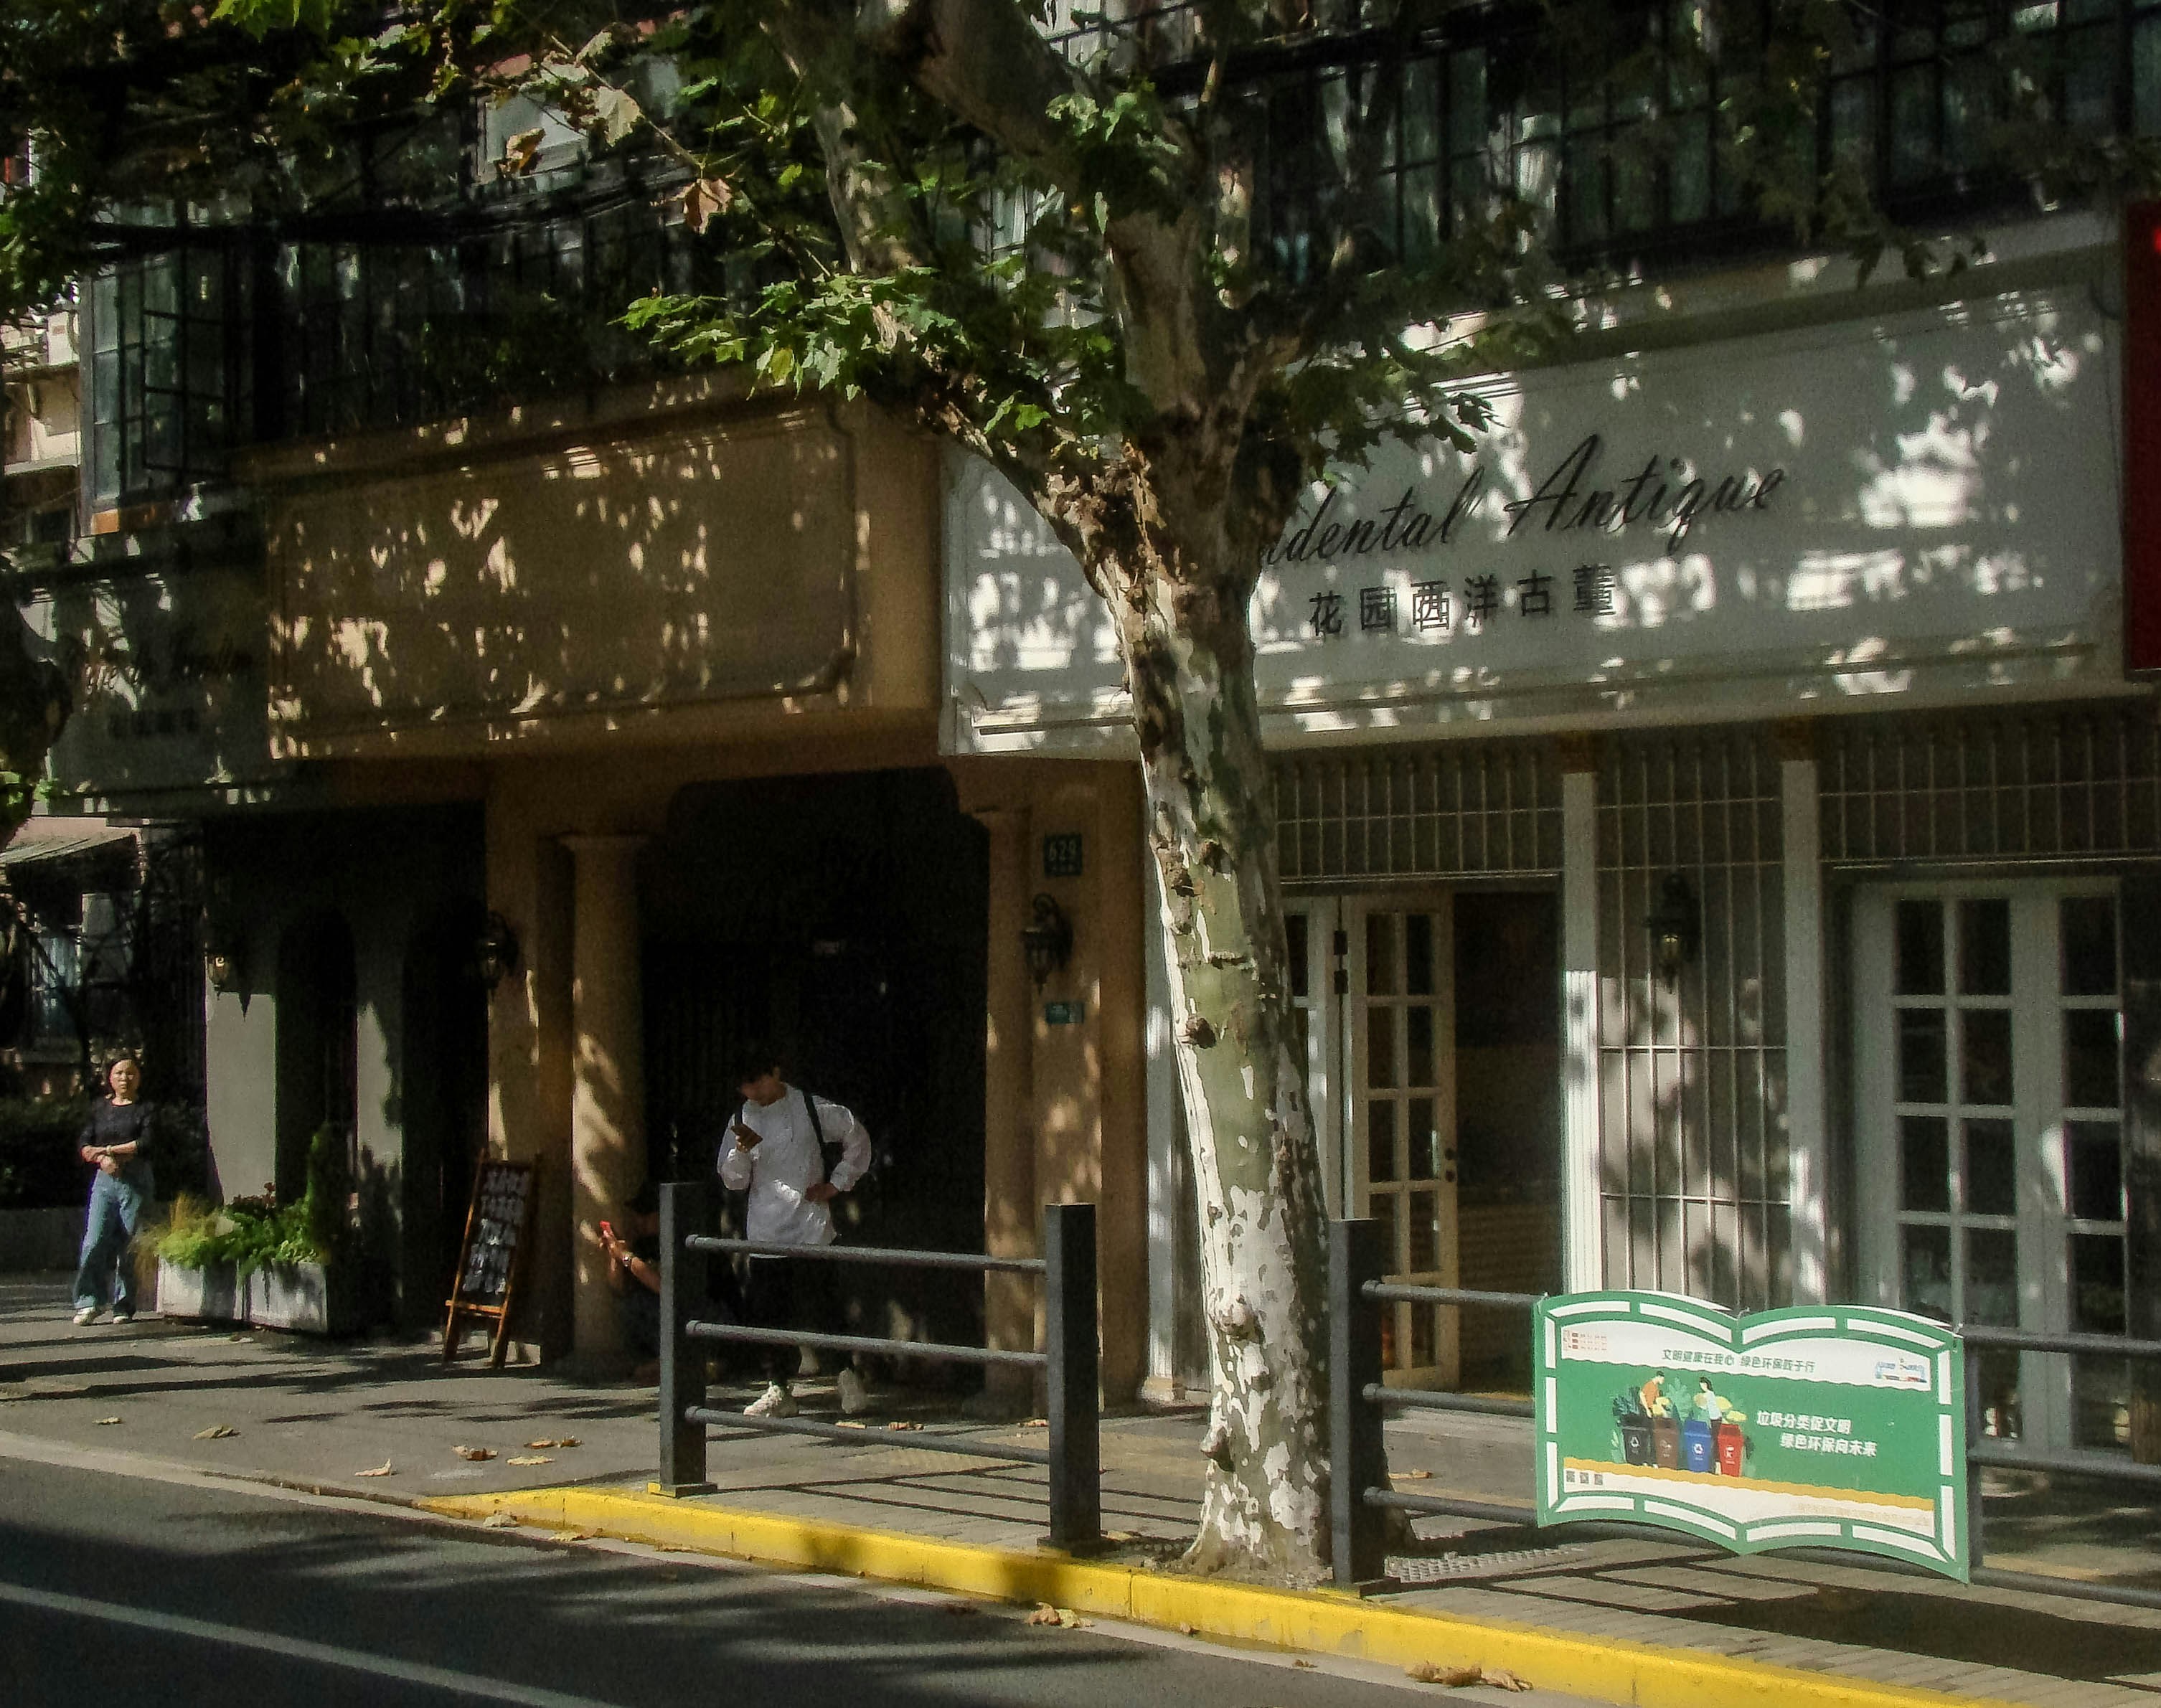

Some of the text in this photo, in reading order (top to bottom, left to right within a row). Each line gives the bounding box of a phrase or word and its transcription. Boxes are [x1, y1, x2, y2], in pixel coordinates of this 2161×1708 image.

[1505, 433, 1785, 553] Antique
[1309, 563, 1616, 637] 花园西洋古董
[1662, 1349, 1735, 1366] 文明健康在我心
[1756, 1410, 1852, 1435] 垃圾分类促文明
[1779, 1432, 1878, 1457] 绿色环保向未来
